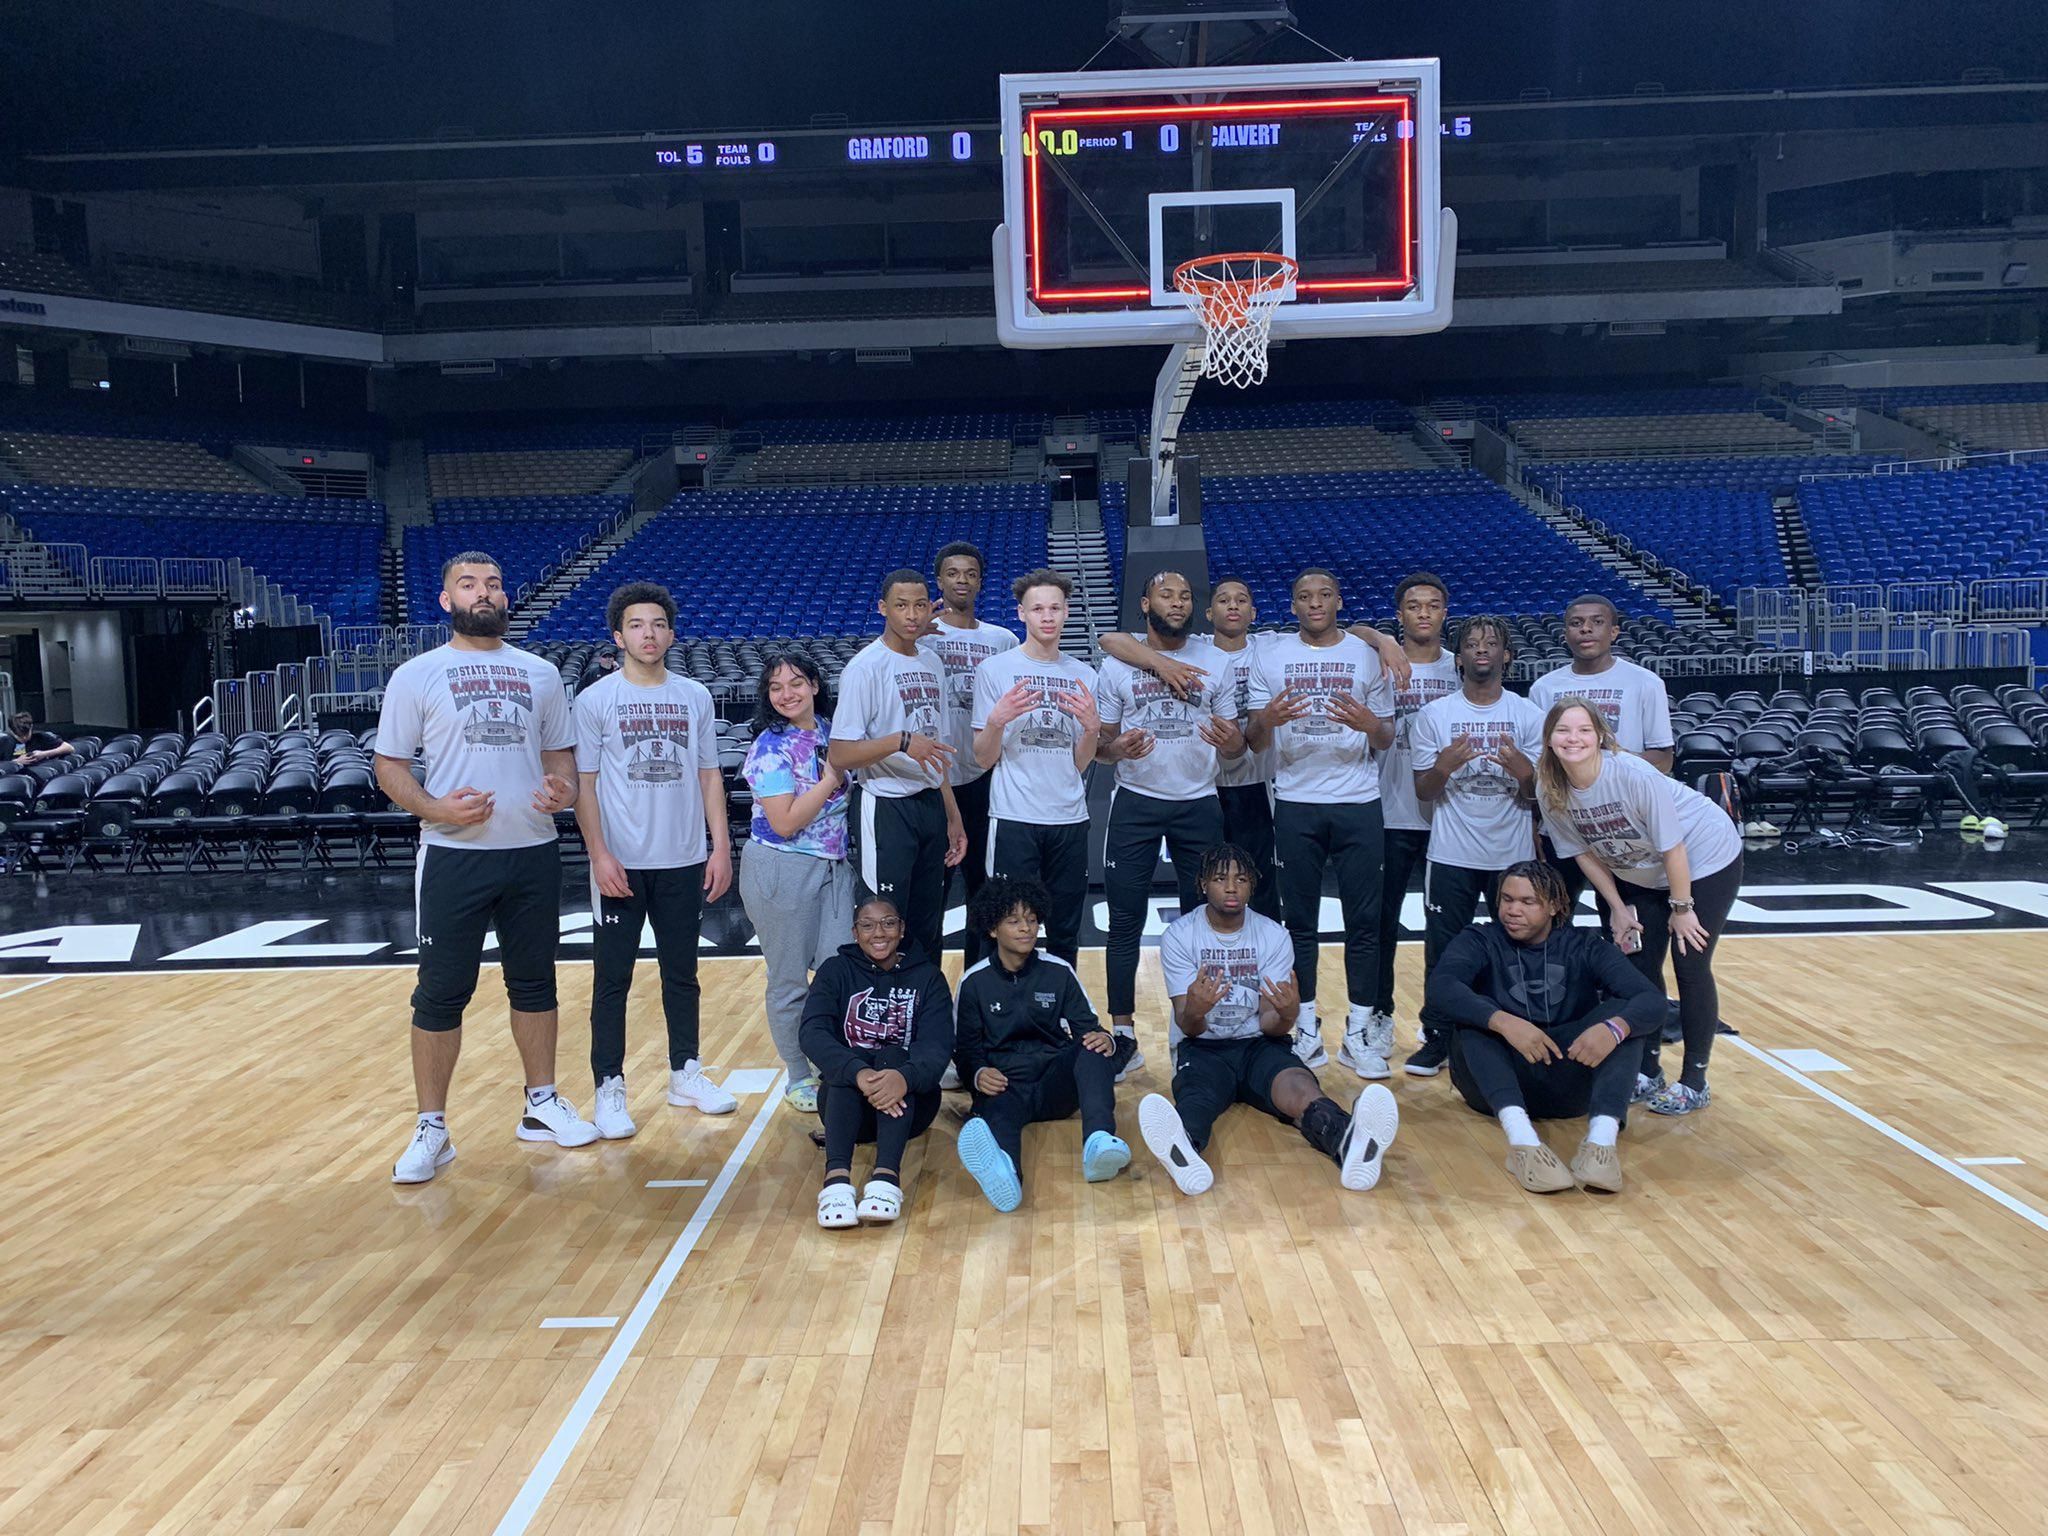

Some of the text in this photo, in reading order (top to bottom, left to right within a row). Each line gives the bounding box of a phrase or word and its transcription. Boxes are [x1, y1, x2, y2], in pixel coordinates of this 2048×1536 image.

[1455, 117, 1471, 137] 5
[1079, 130, 1133, 150] PERIOD 1
[1160, 124, 1179, 152] 0
[717, 144, 748, 154] TEAM
[758, 142, 775, 162] 0
[848, 132, 971, 160] GRAFORD 0
[656, 145, 703, 164] TOL 5
[716, 155, 751, 166] FOULS
[946, 641, 968, 652] STATE
[447, 667, 459, 679] 20
[459, 665, 488, 677] STATE
[489, 665, 517, 677] BOUND
[1285, 662, 1356, 674] 20 STATE BOUND 22
[1588, 689, 1612, 700] BOUND
[617, 704, 628, 716] 20
[628, 702, 653, 715] STATE
[654, 702, 680, 715] BOUND
[1461, 722, 1486, 733] STATE
